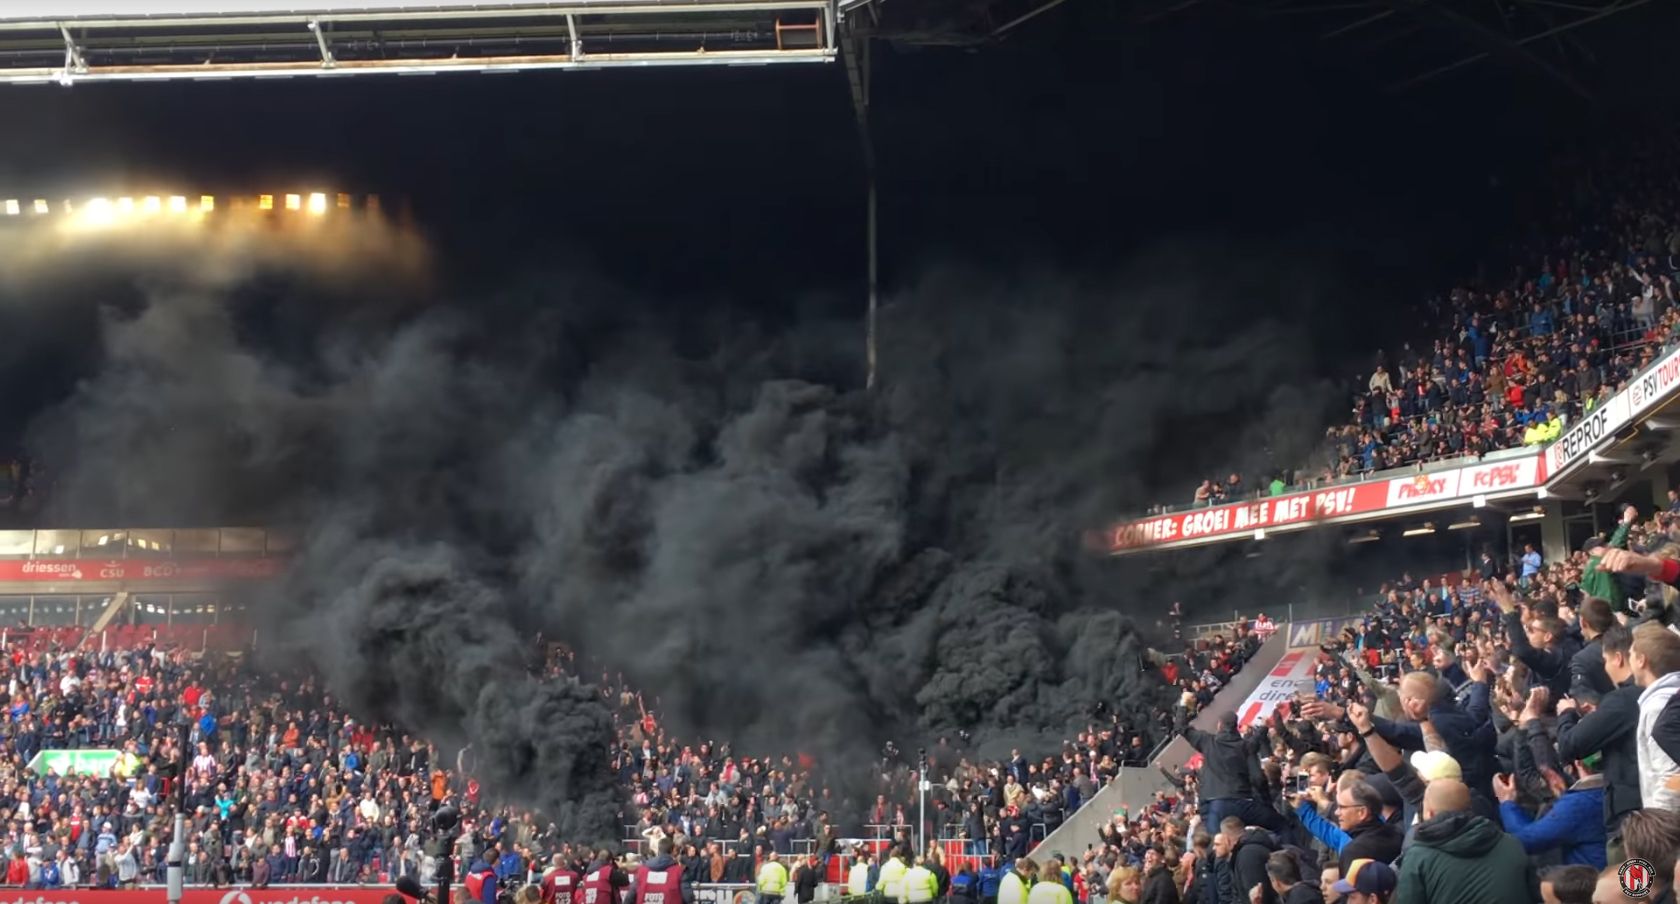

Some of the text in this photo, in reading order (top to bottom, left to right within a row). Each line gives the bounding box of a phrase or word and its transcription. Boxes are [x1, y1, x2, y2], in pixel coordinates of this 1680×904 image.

[1562, 408, 1608, 463] REPROF
[1182, 509, 1230, 537] GROEI
[1234, 502, 1269, 529] MEE
[1273, 496, 1310, 523] MET
[1315, 487, 1356, 515] PSV!
[22, 561, 77, 573] driessen
[100, 568, 125, 578] CSU
